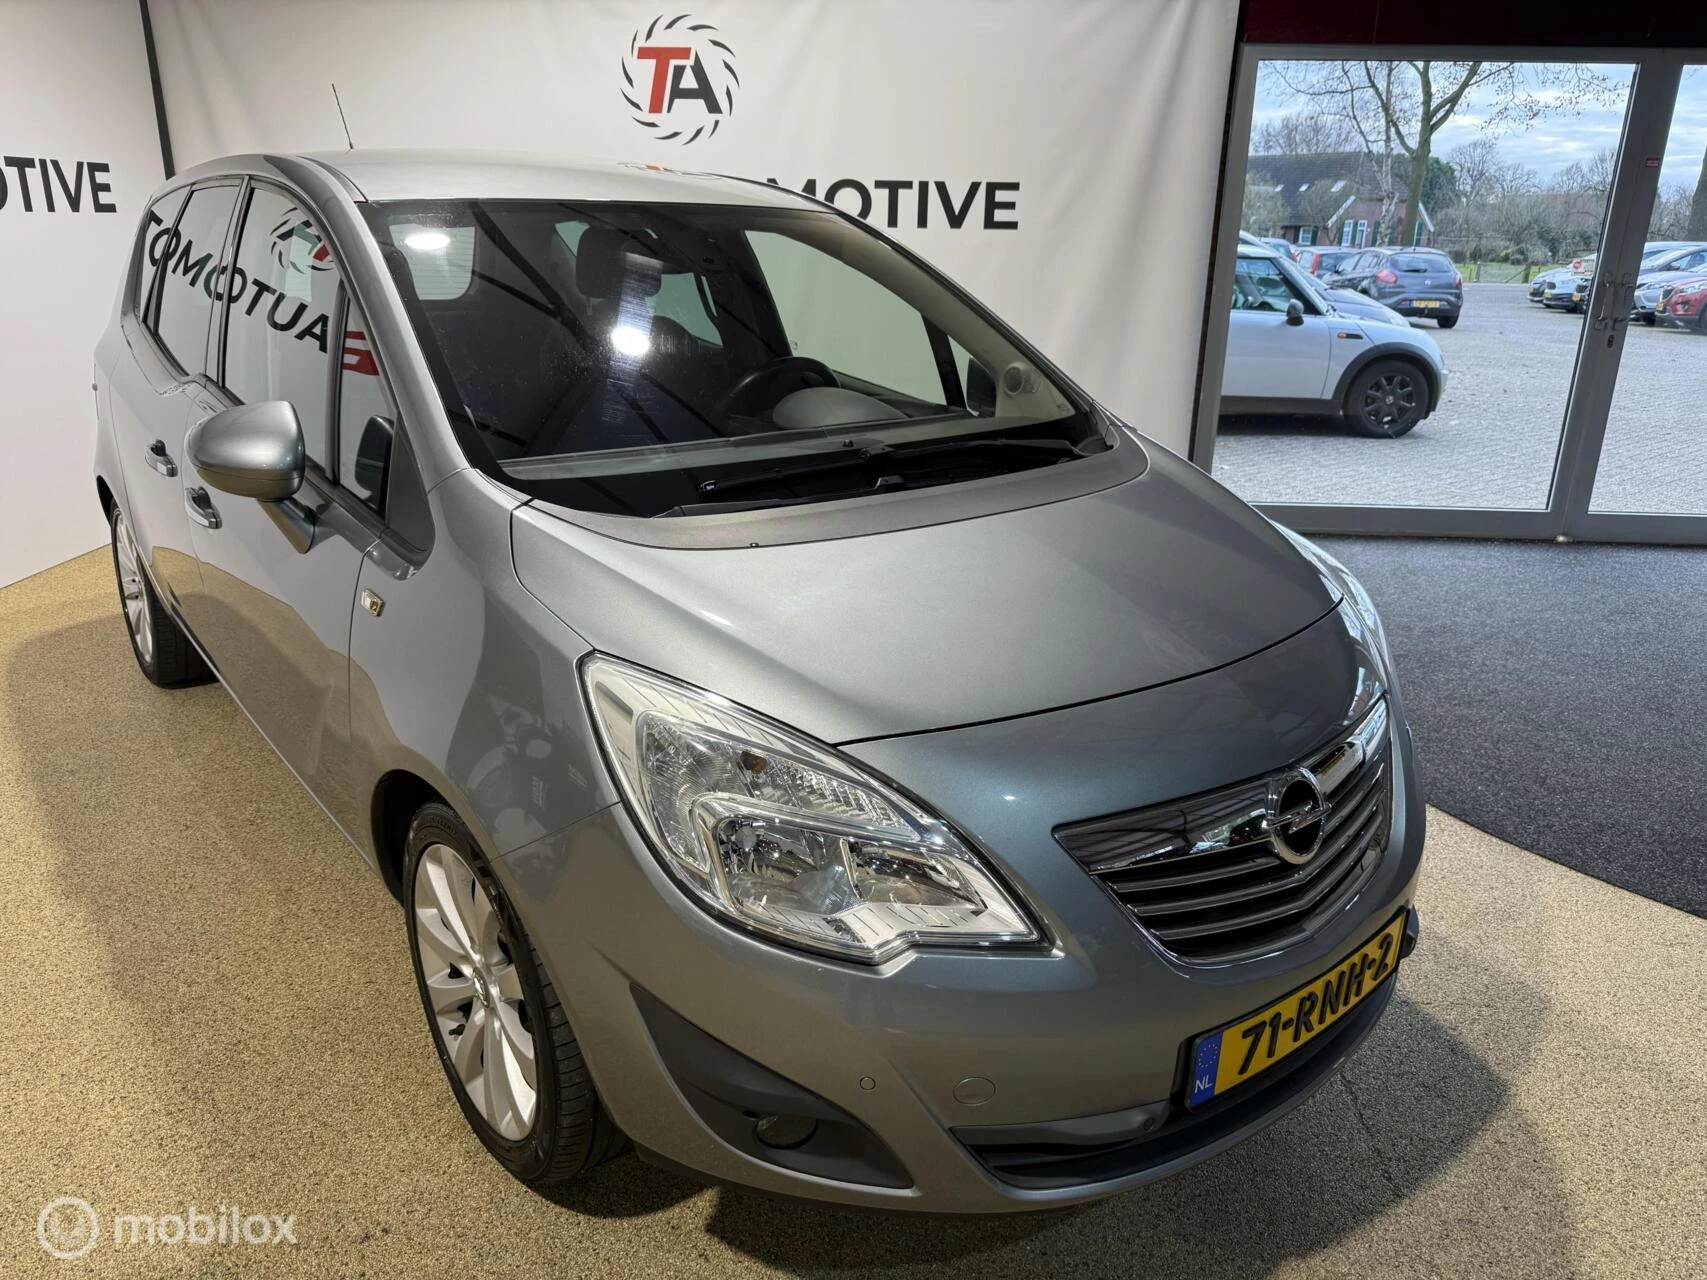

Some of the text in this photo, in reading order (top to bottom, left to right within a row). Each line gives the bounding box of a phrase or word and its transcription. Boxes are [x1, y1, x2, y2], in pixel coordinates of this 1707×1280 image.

[637, 47, 723, 114] TA
[0, 155, 117, 213] TIVE
[1238, 933, 1394, 1075] 71-RNH-2
[1194, 1074, 1213, 1094] NL
